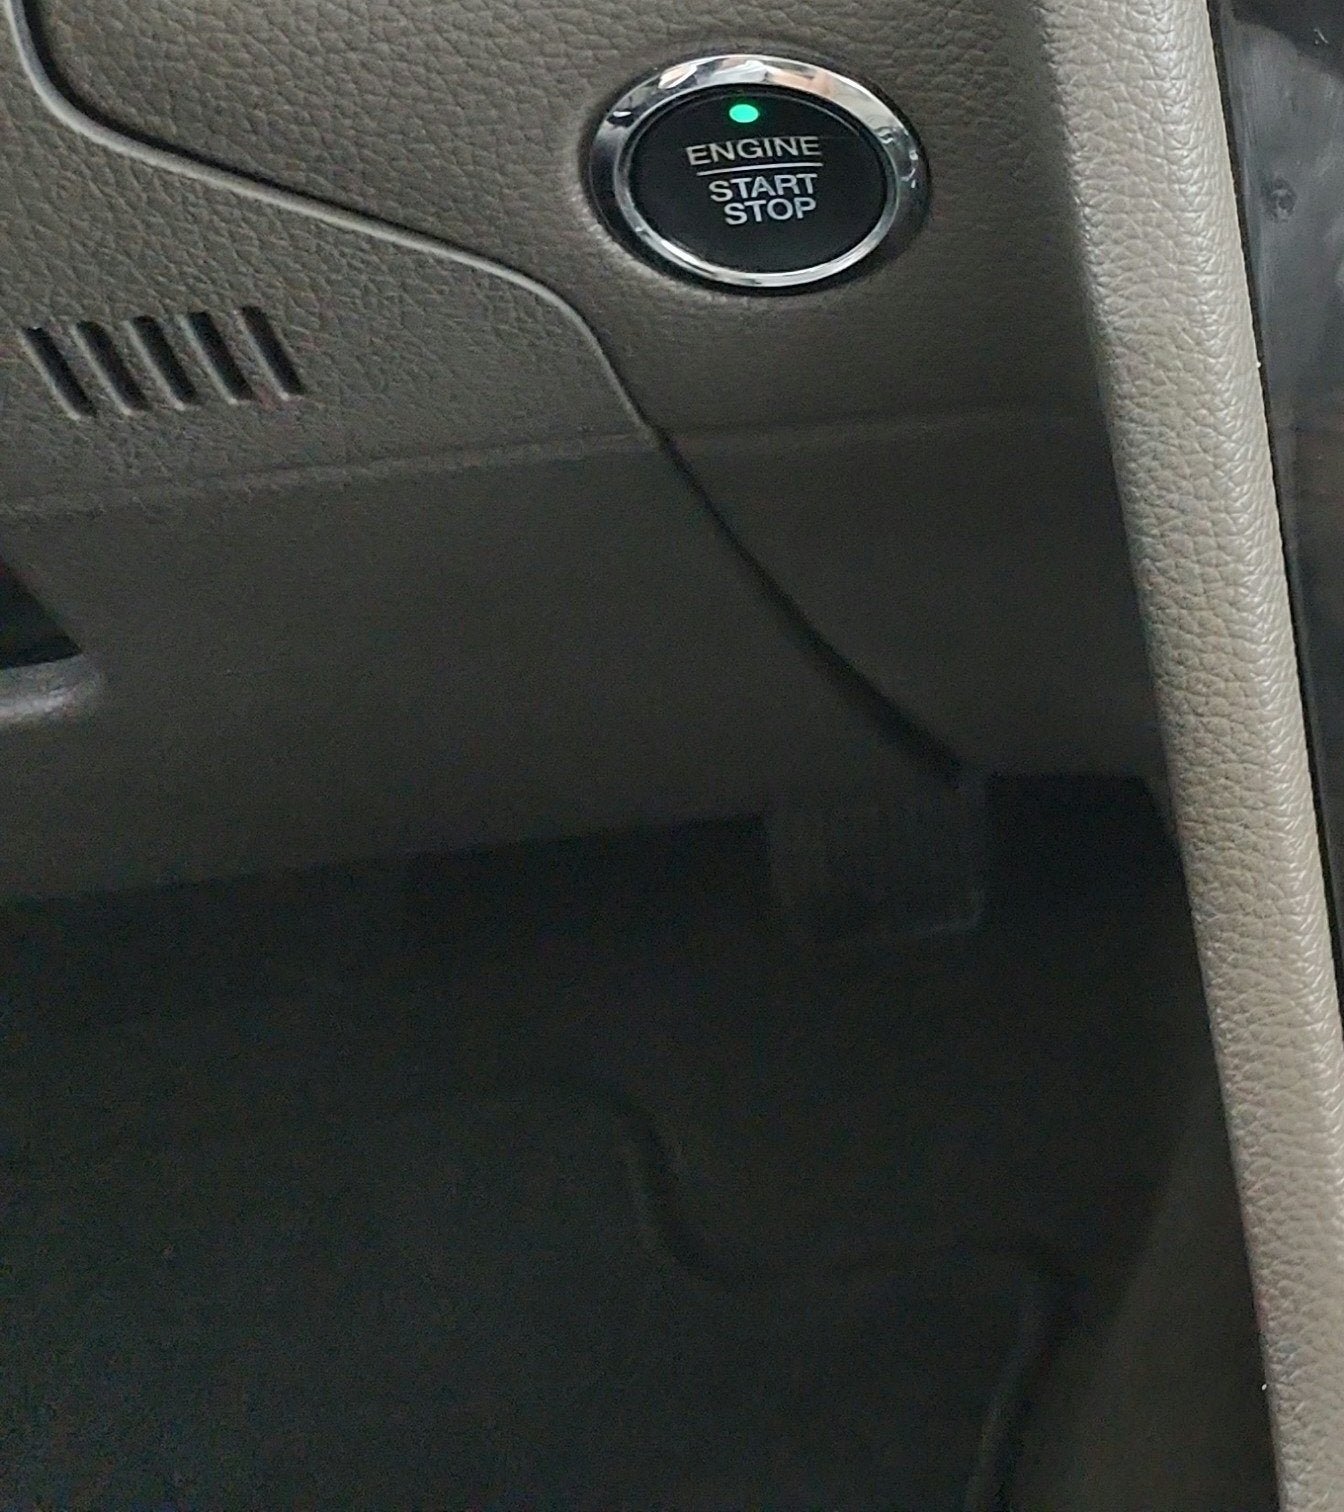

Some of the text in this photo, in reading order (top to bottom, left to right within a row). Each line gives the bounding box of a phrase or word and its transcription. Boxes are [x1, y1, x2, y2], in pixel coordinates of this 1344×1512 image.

[685, 135, 823, 167] ENGINE
[708, 173, 818, 203] START
[723, 197, 817, 226] STOP
